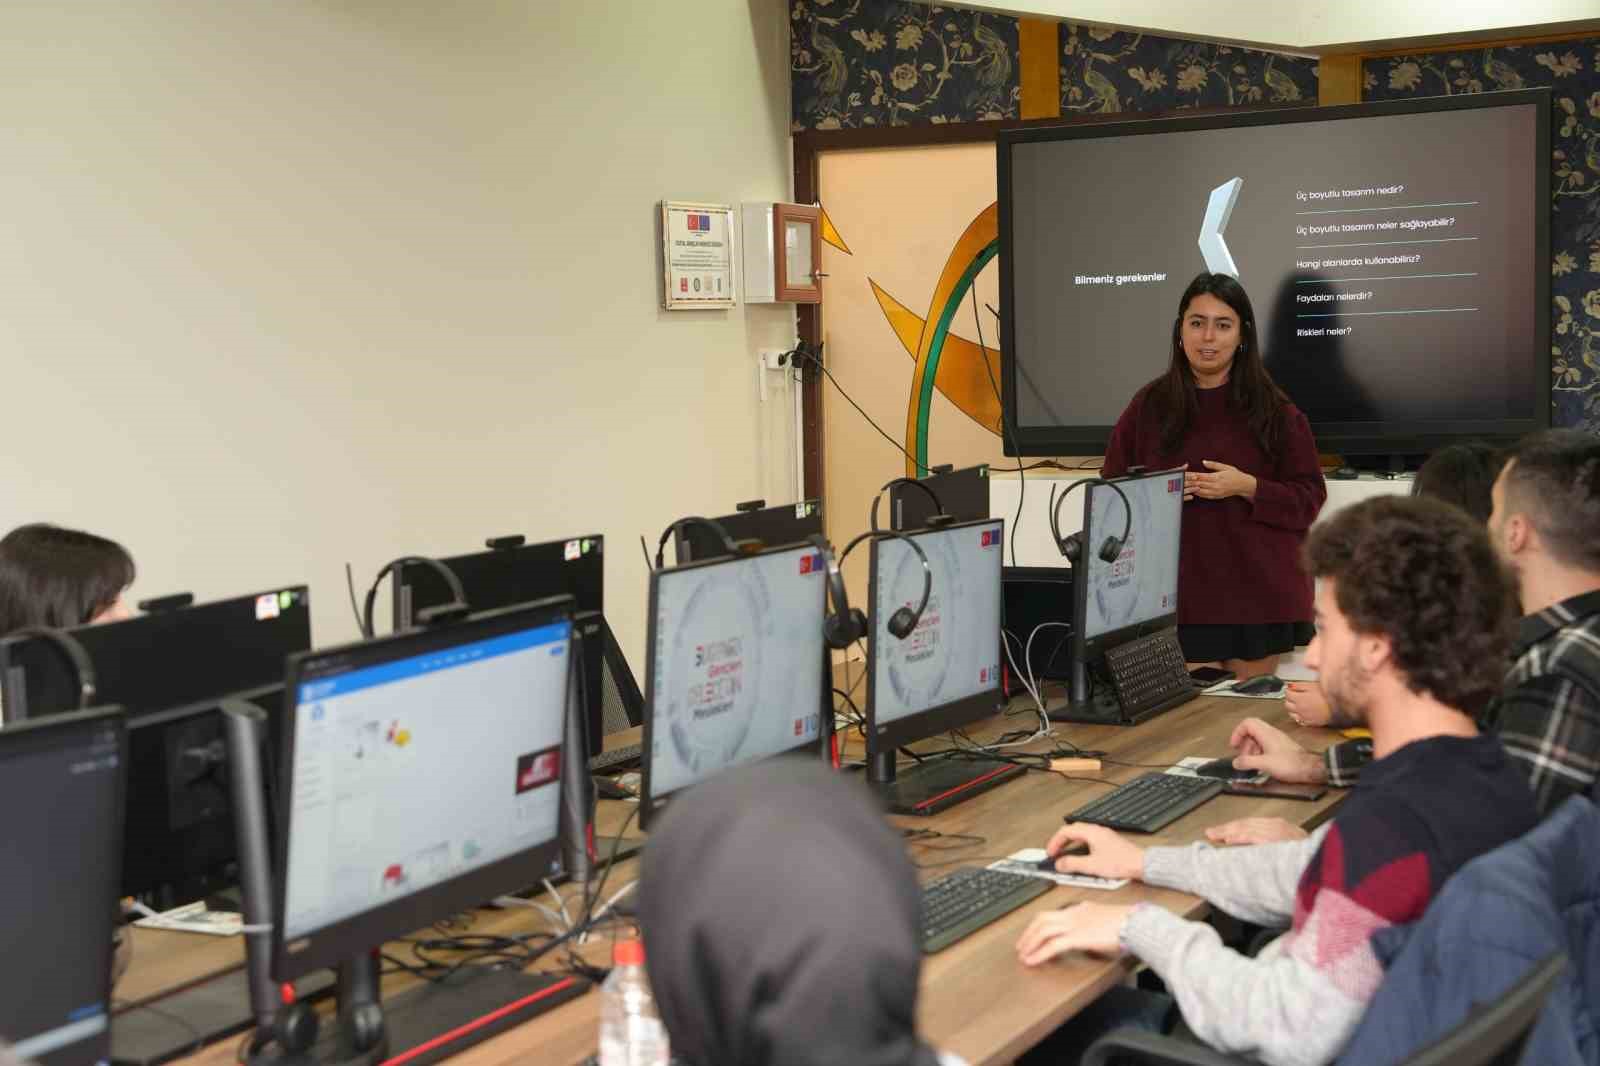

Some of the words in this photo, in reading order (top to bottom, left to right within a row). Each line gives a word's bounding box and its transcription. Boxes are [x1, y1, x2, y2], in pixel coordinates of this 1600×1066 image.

[1309, 189, 1340, 200] boyutlu
[1341, 188, 1375, 197] tasarım
[1376, 185, 1404, 195] nedir?
[1309, 224, 1340, 235] boyutlu
[1341, 223, 1375, 231] tasarım
[1376, 221, 1398, 230] neler
[1399, 216, 1455, 231] sağlayabilir?
[1296, 259, 1320, 270] Hangi
[1322, 257, 1363, 268] alanlarda
[1364, 254, 1421, 266] kullanabiliriz?
[1075, 274, 1114, 285] Bilmeniz
[1115, 272, 1167, 285] gerekenler
[1296, 292, 1334, 304] Faydaları
[1336, 291, 1373, 301] nelerdir?
[1296, 328, 1324, 336] Riskleri
[1326, 327, 1352, 336] neler?
